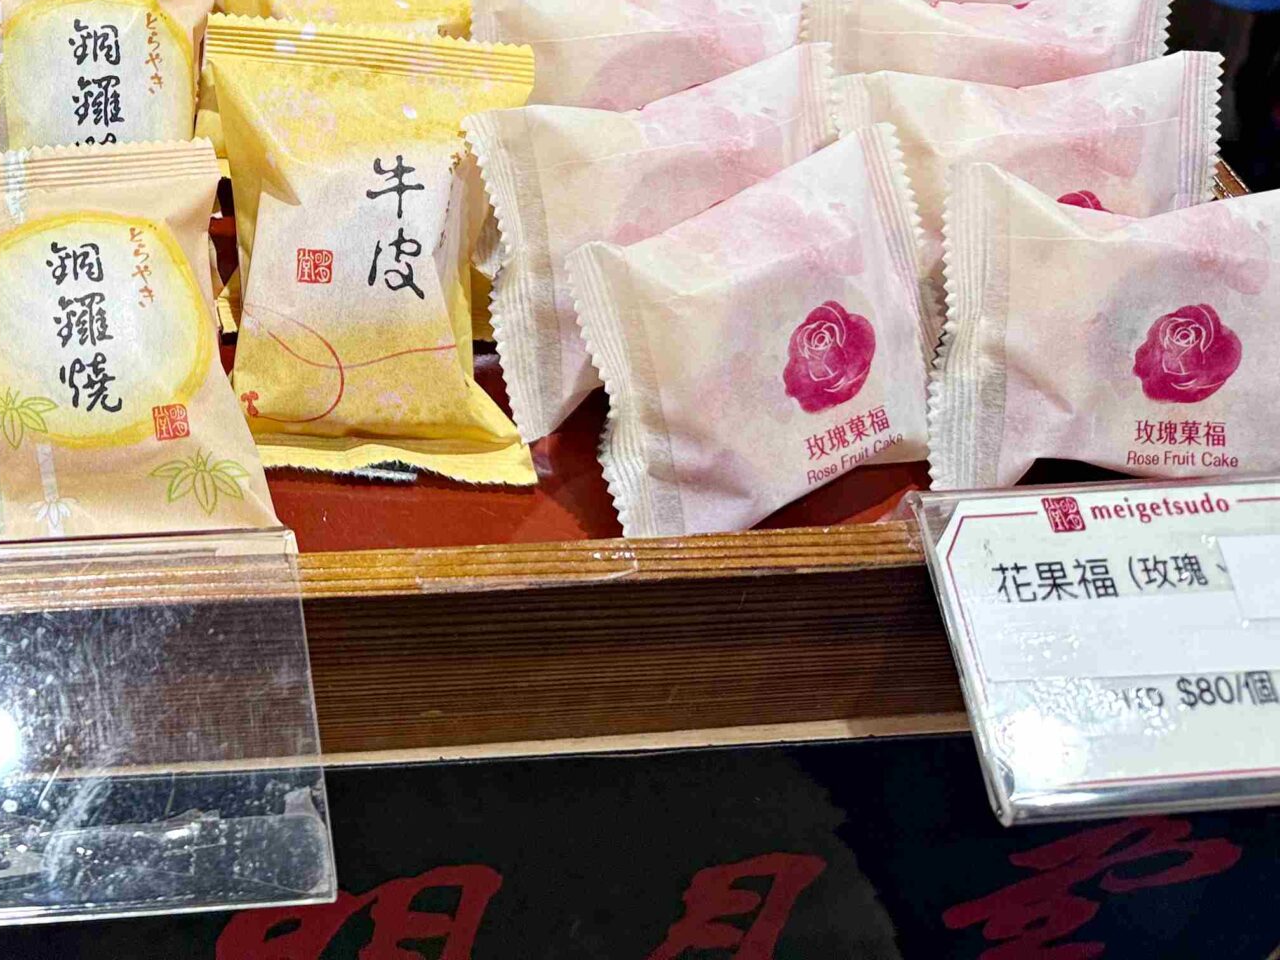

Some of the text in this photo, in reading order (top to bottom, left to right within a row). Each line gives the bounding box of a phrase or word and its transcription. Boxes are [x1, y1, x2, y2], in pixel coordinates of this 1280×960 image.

[144, 11, 167, 95] どらやき
[68, 18, 125, 147] 銅鑼
[366, 154, 425, 301] 牛皮
[129, 224, 157, 308] どらやき
[46, 241, 122, 412] 銅鑼燒
[804, 404, 891, 461] 玫瑰菓福
[806, 432, 904, 485] Rose Fruit Cake
[1126, 450, 1240, 469] Rose Fruit Cake
[1134, 419, 1228, 448] 玫瑰菓福
[1090, 492, 1231, 524] meigetsudo
[991, 558, 1120, 604] 花果福
[1176, 669, 1279, 712] $80/個
